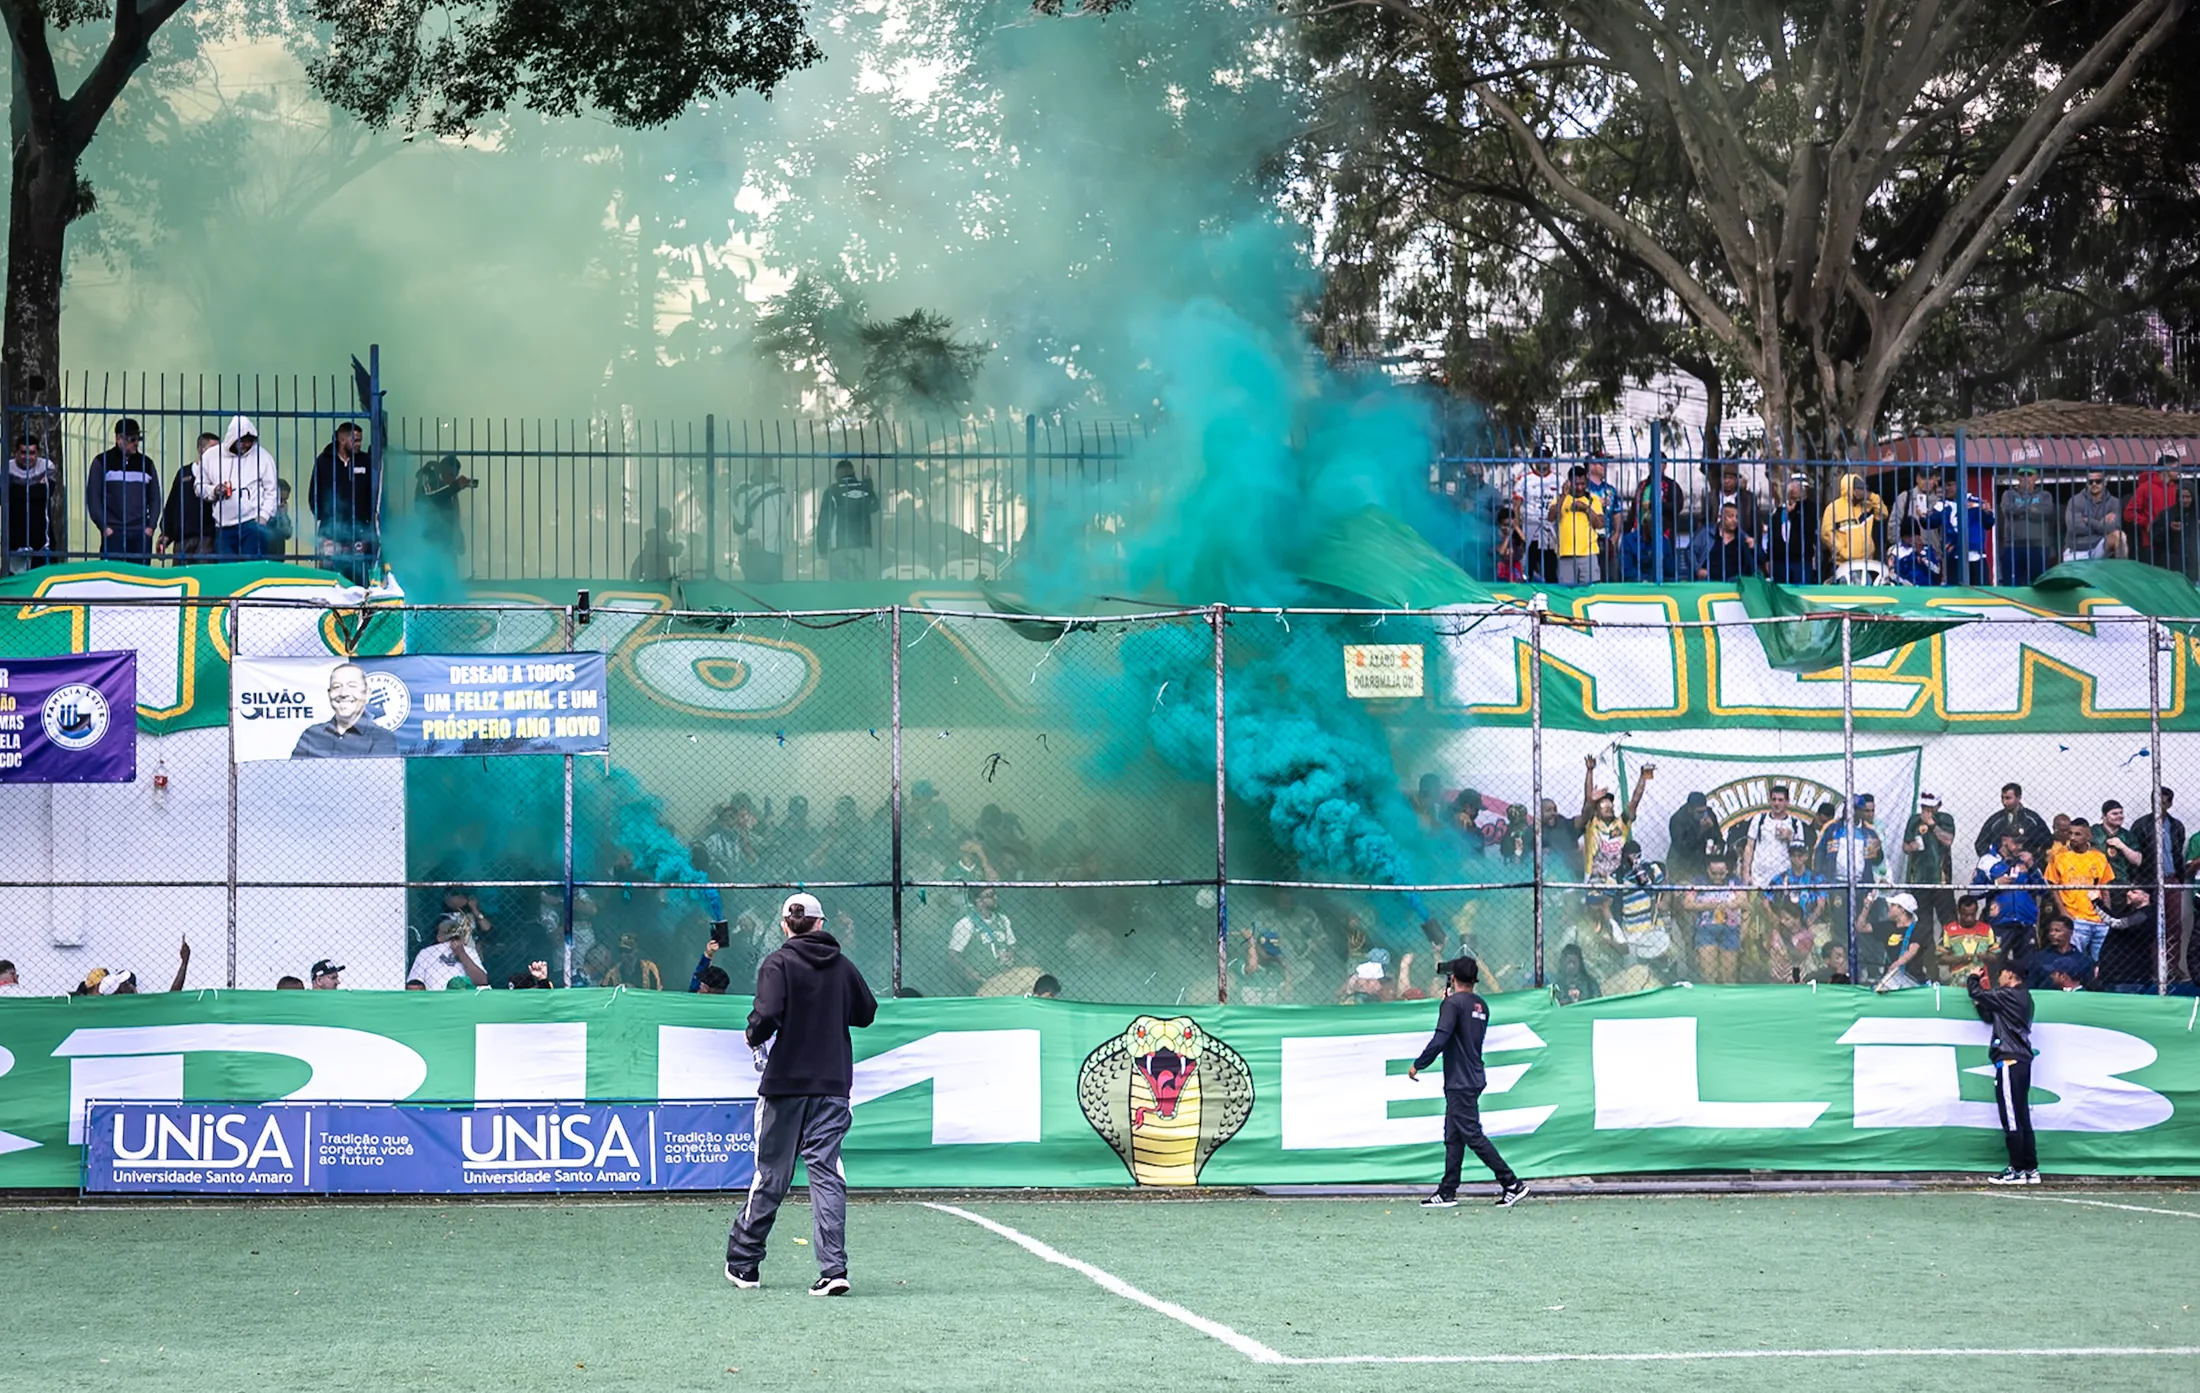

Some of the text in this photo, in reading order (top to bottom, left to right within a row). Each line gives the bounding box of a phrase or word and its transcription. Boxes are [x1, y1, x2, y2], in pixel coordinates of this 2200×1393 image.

[450, 663, 576, 685] DESEJO A TODOS
[85, 690, 105, 718] LEITE
[241, 688, 306, 705] SILVÃO
[423, 689, 598, 713] UM FELIZ NATAL E UM
[265, 706, 315, 719] LEITE
[422, 713, 601, 741] PRÓSPERO ANO NOVO
[318, 1131, 409, 1148] Tradição que
[664, 1130, 752, 1146] Tradição que
[318, 1143, 414, 1155] conecta você
[664, 1141, 757, 1154] conecta você
[318, 1155, 385, 1166] ao futuro
[664, 1152, 729, 1164] ao futuro
[112, 1170, 294, 1184] Universidade Santo Amaro
[463, 1169, 641, 1184] Universidade Santo Amaro
